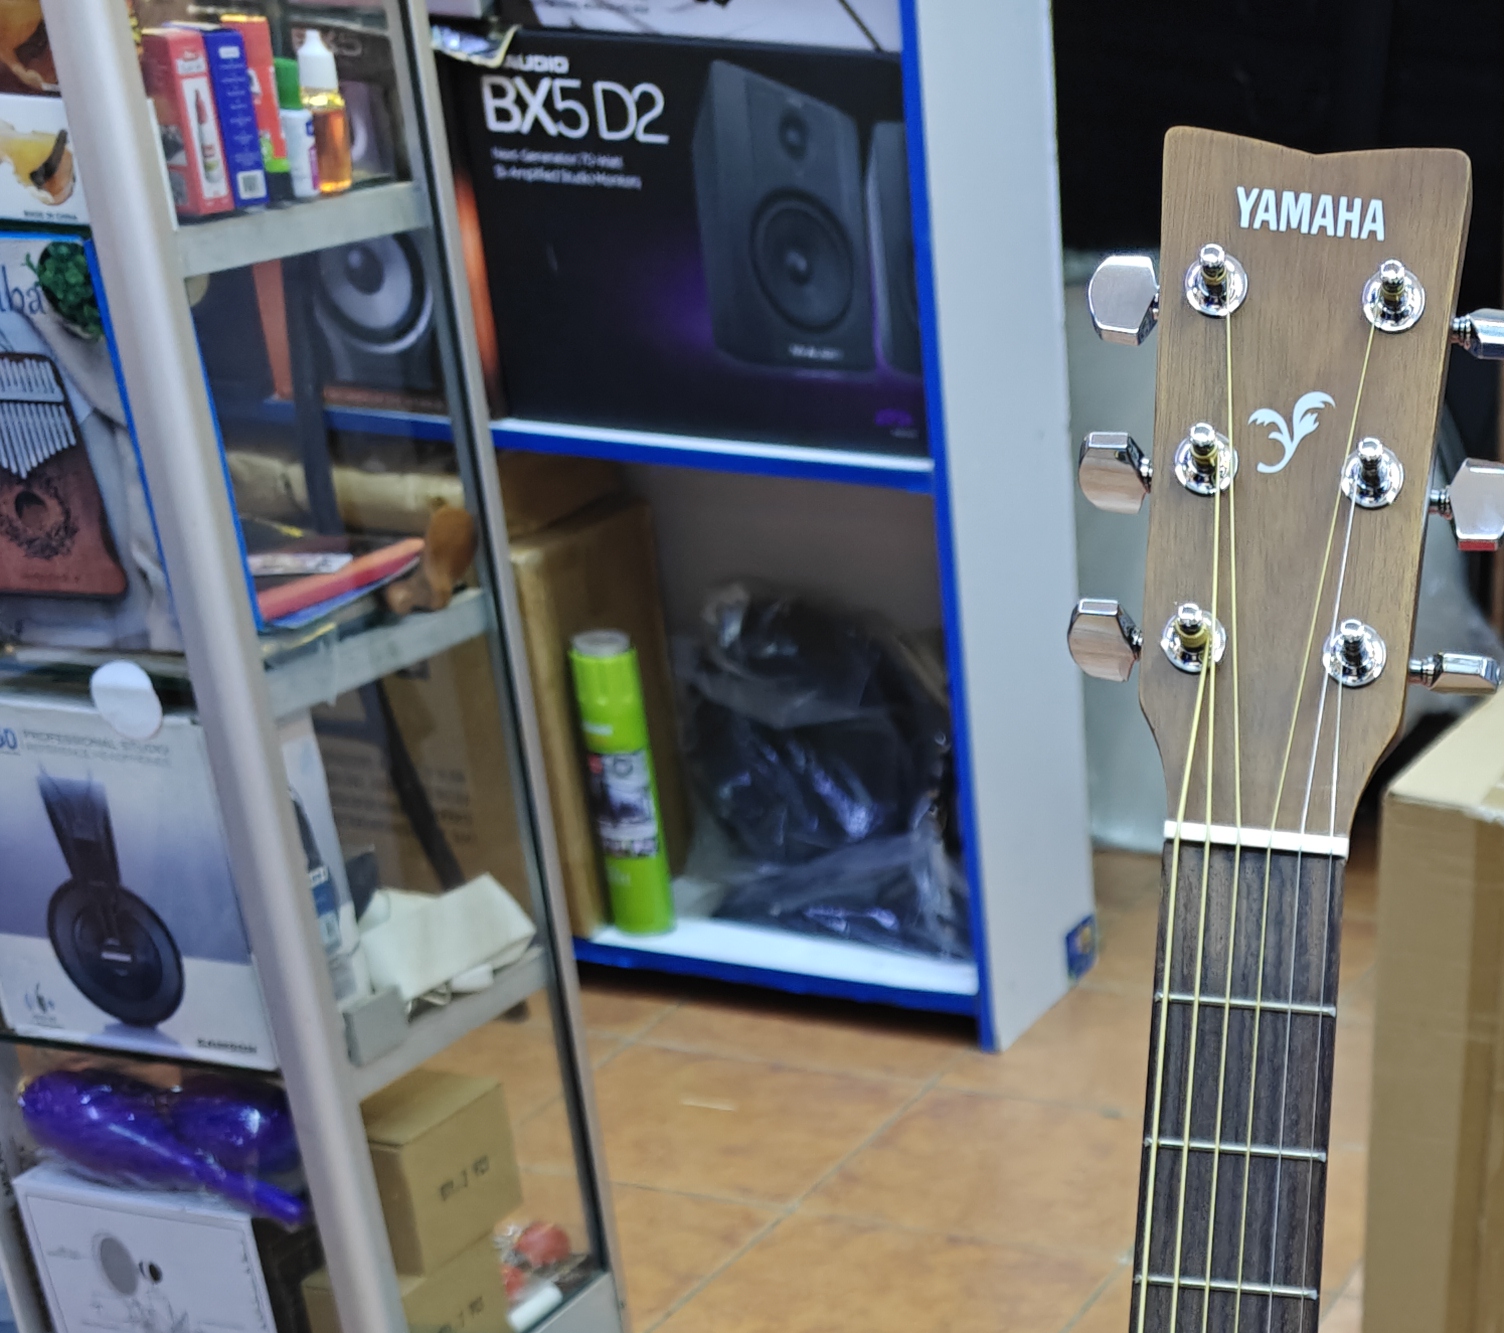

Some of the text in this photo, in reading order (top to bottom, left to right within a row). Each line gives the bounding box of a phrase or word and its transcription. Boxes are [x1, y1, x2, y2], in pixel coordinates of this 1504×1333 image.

[481, 75, 670, 144] BX5 D2
[1236, 186, 1386, 242] YAMAHA
